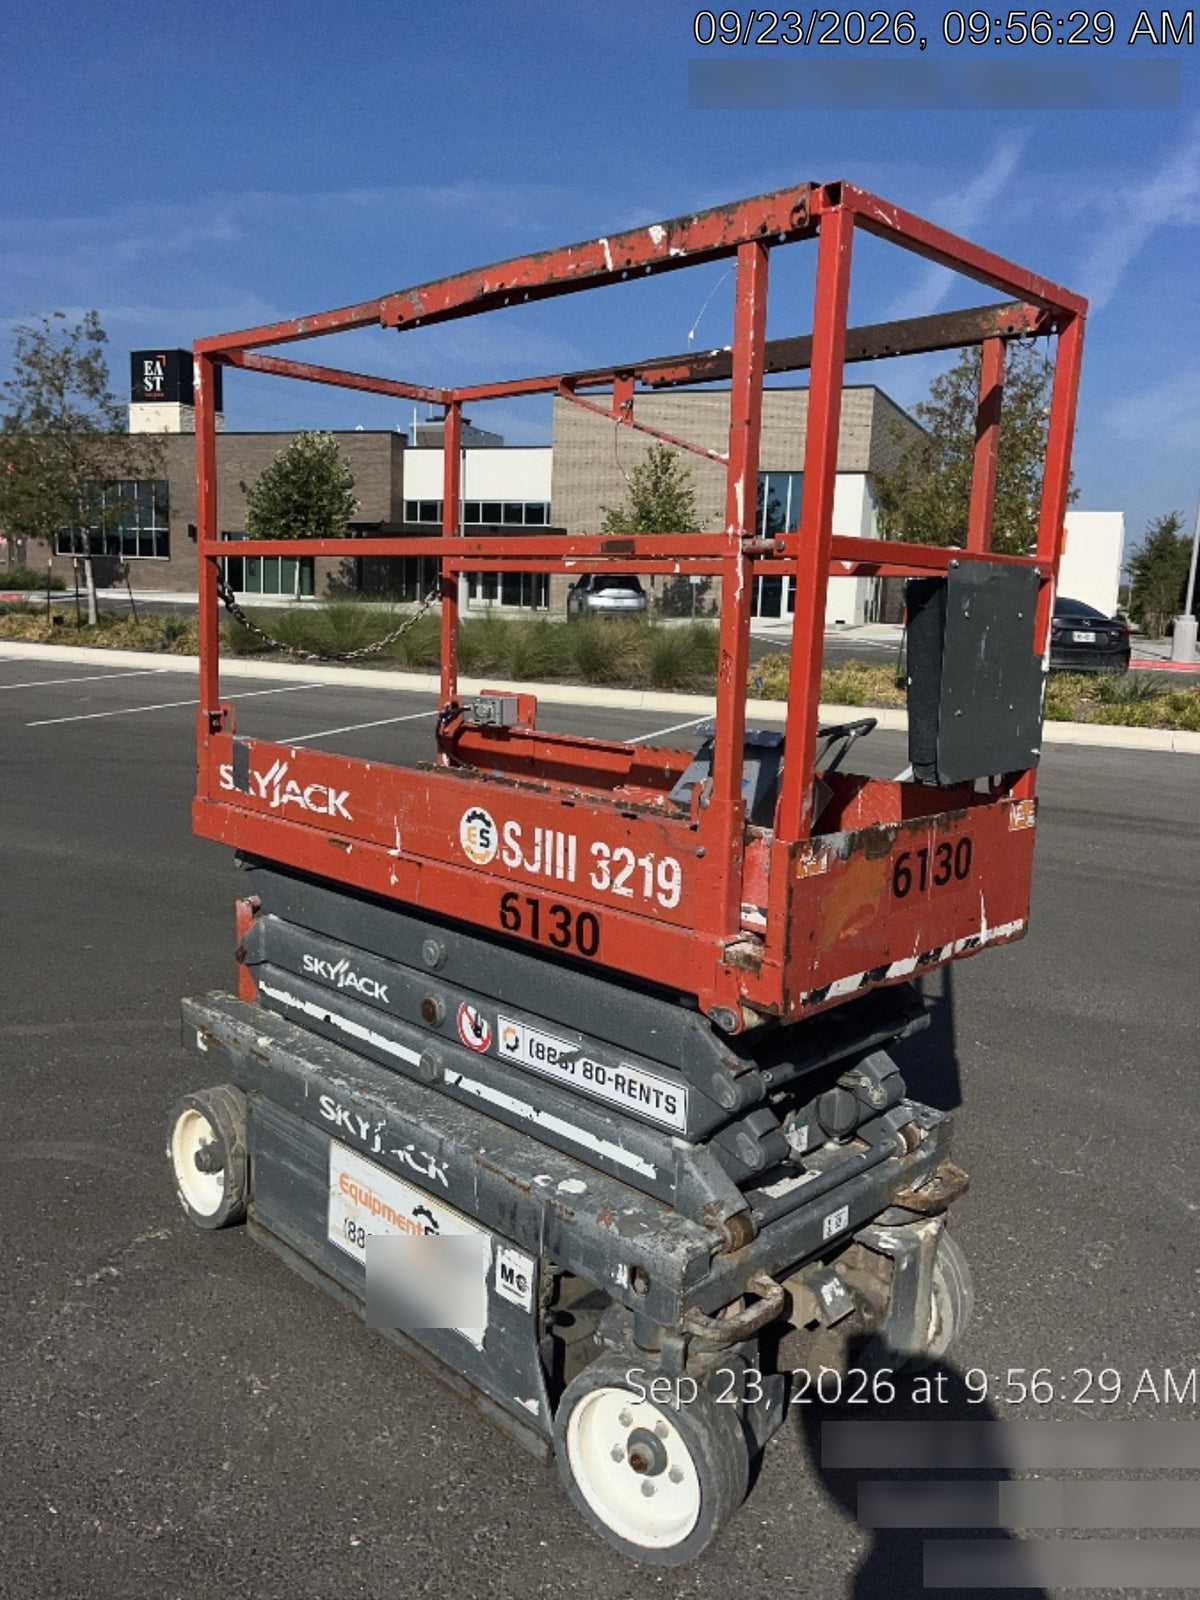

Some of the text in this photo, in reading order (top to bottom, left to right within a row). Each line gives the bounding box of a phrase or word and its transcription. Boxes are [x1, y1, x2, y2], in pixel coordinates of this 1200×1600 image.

[219, 758, 353, 822] SYJACK
[589, 841, 682, 909] 3219
[892, 836, 972, 899] 6130
[500, 891, 600, 957] 6130
[303, 953, 390, 1003] SKYJACK
[583, 1060, 677, 1115] 80-RENTS
[319, 1094, 449, 1188] SKYJCK
